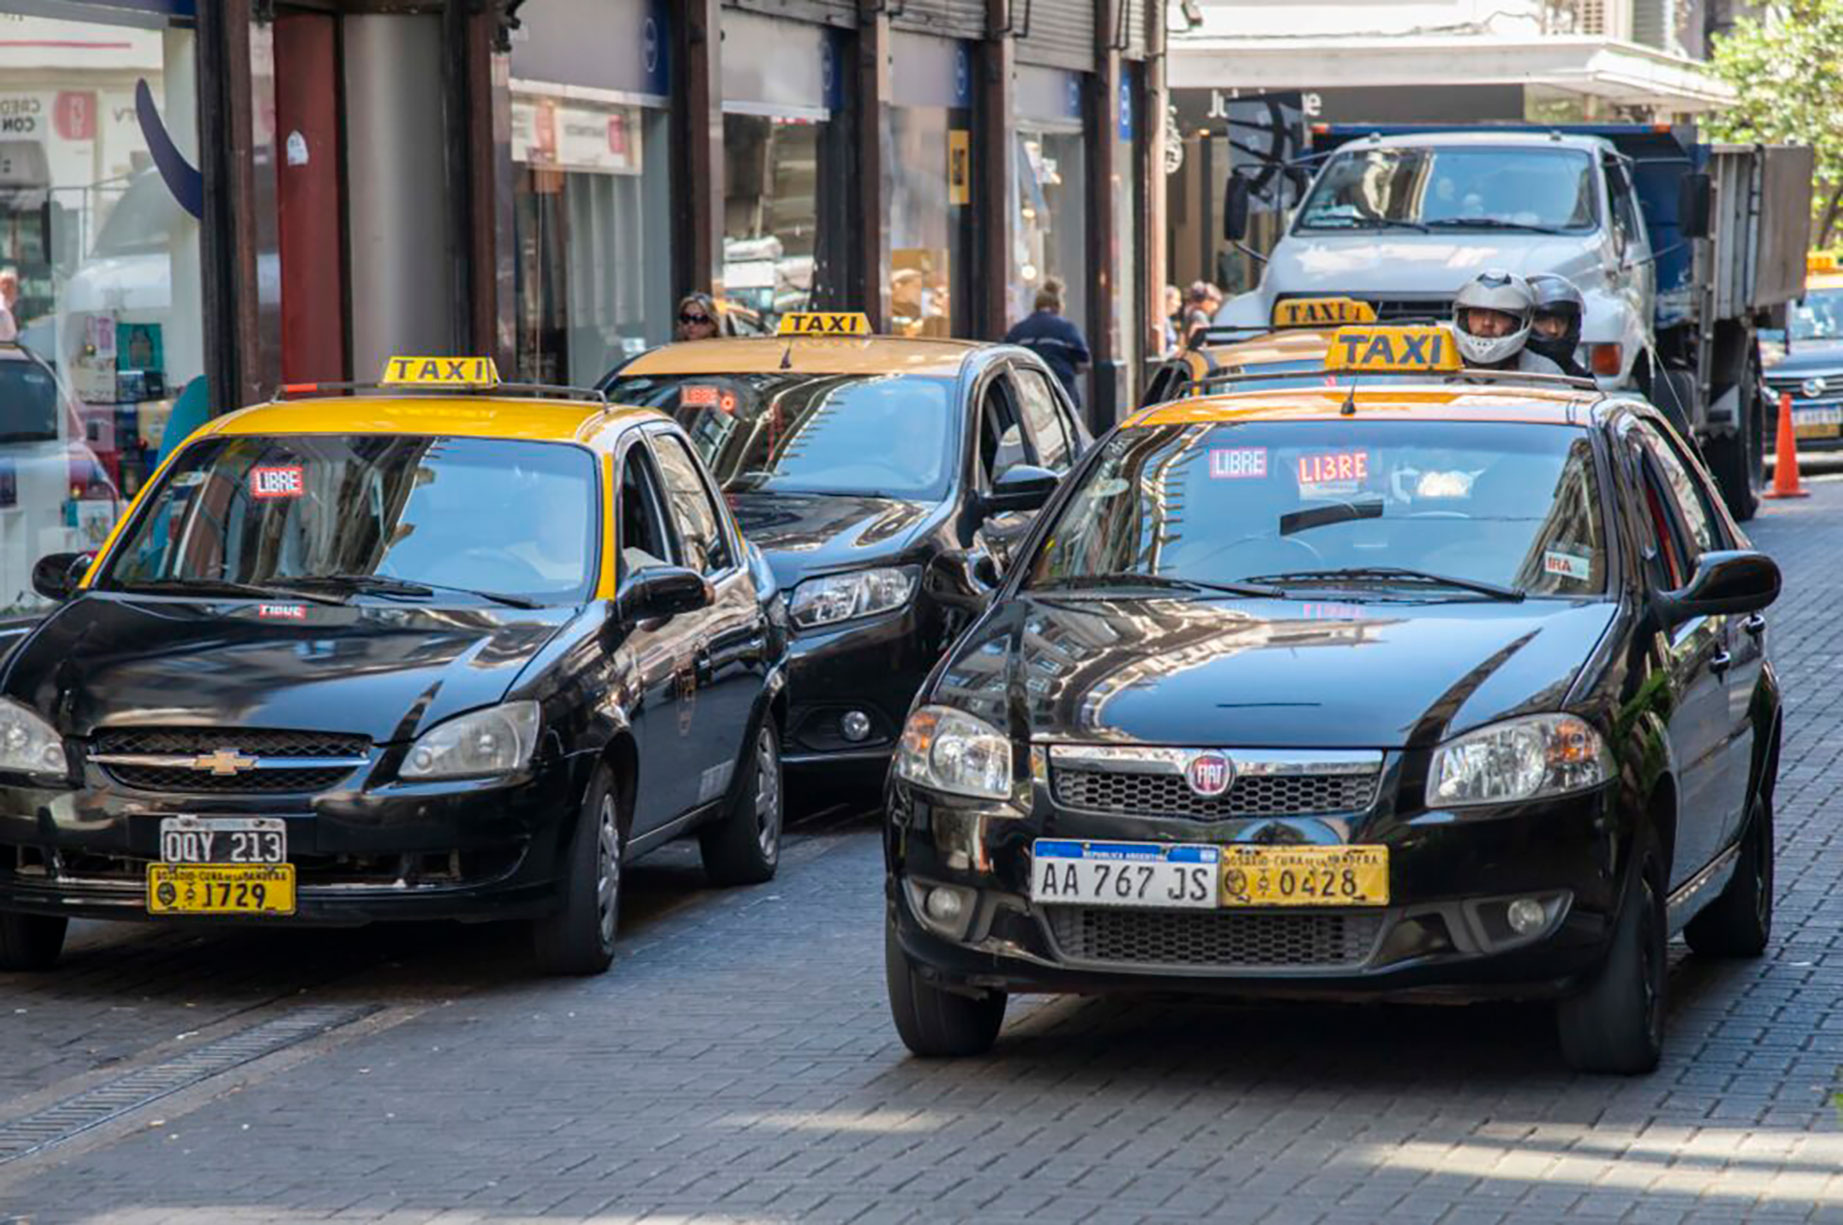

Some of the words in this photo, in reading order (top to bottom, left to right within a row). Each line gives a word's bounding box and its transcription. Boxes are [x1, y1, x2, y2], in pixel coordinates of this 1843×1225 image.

[790, 315, 857, 331] TAXI
[1339, 334, 1442, 364] TAXI
[393, 360, 482, 379] TAXI
[1215, 451, 1265, 475] LIBRE
[256, 470, 300, 493] LIBRE
[1197, 763, 1224, 785] FIAT
[230, 832, 281, 862] 213
[1041, 863, 1079, 896] AA
[1093, 864, 1155, 899] 767
[1167, 867, 1209, 901] JS
[1279, 868, 1357, 897] 0428
[201, 882, 266, 909] 1729
